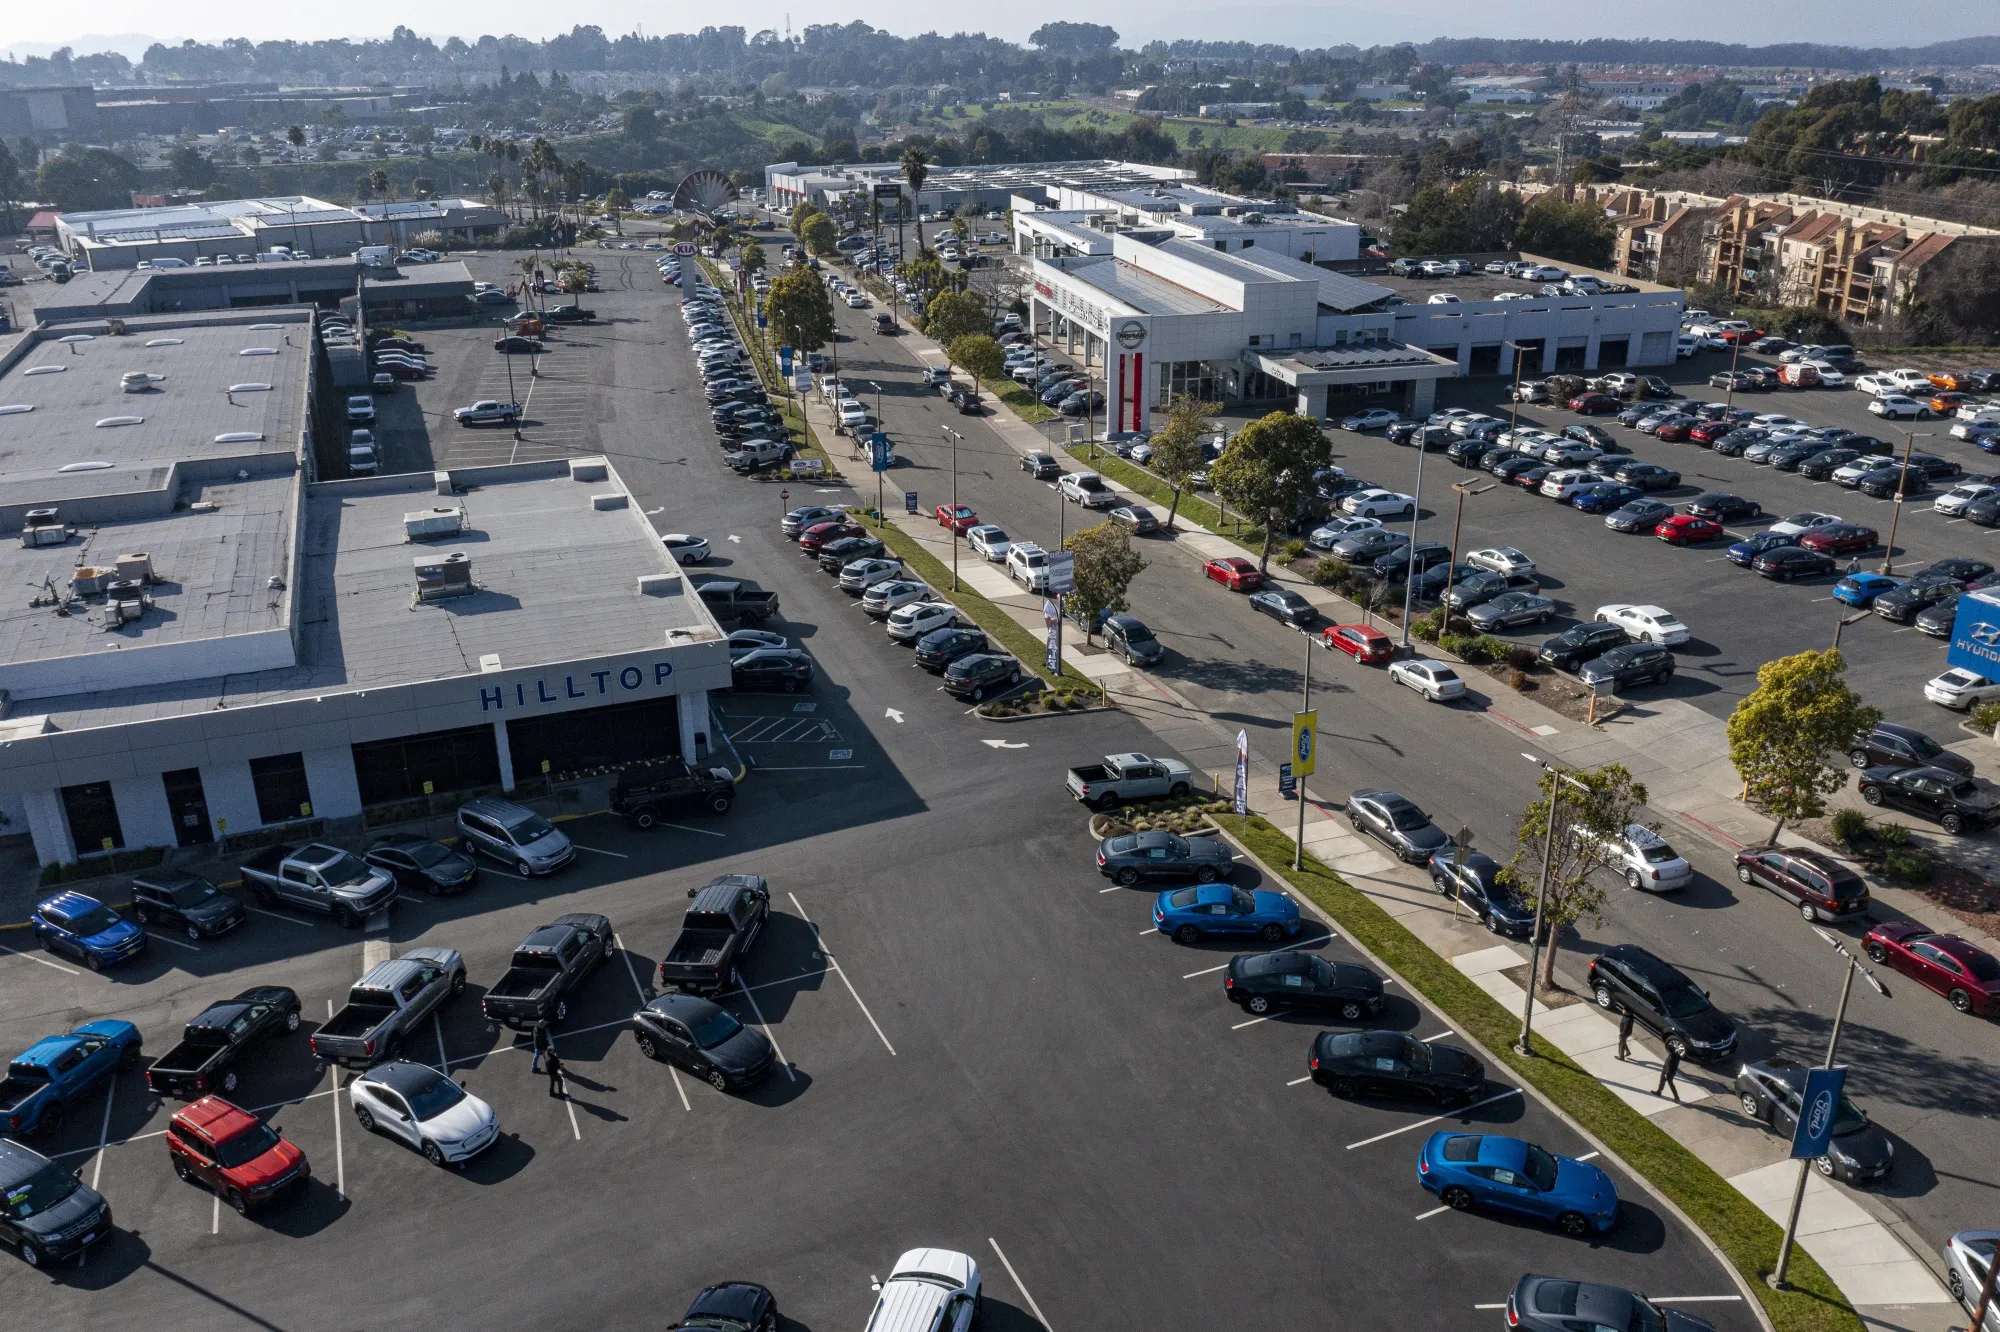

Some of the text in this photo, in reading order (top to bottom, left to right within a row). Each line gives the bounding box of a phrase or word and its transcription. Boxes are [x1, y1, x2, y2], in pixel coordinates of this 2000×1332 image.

[677, 245, 695, 253] KIA
[1956, 638, 2000, 664] HYUND
[479, 660, 674, 712] HILLTOP
[1810, 1099, 1829, 1130] Ford
